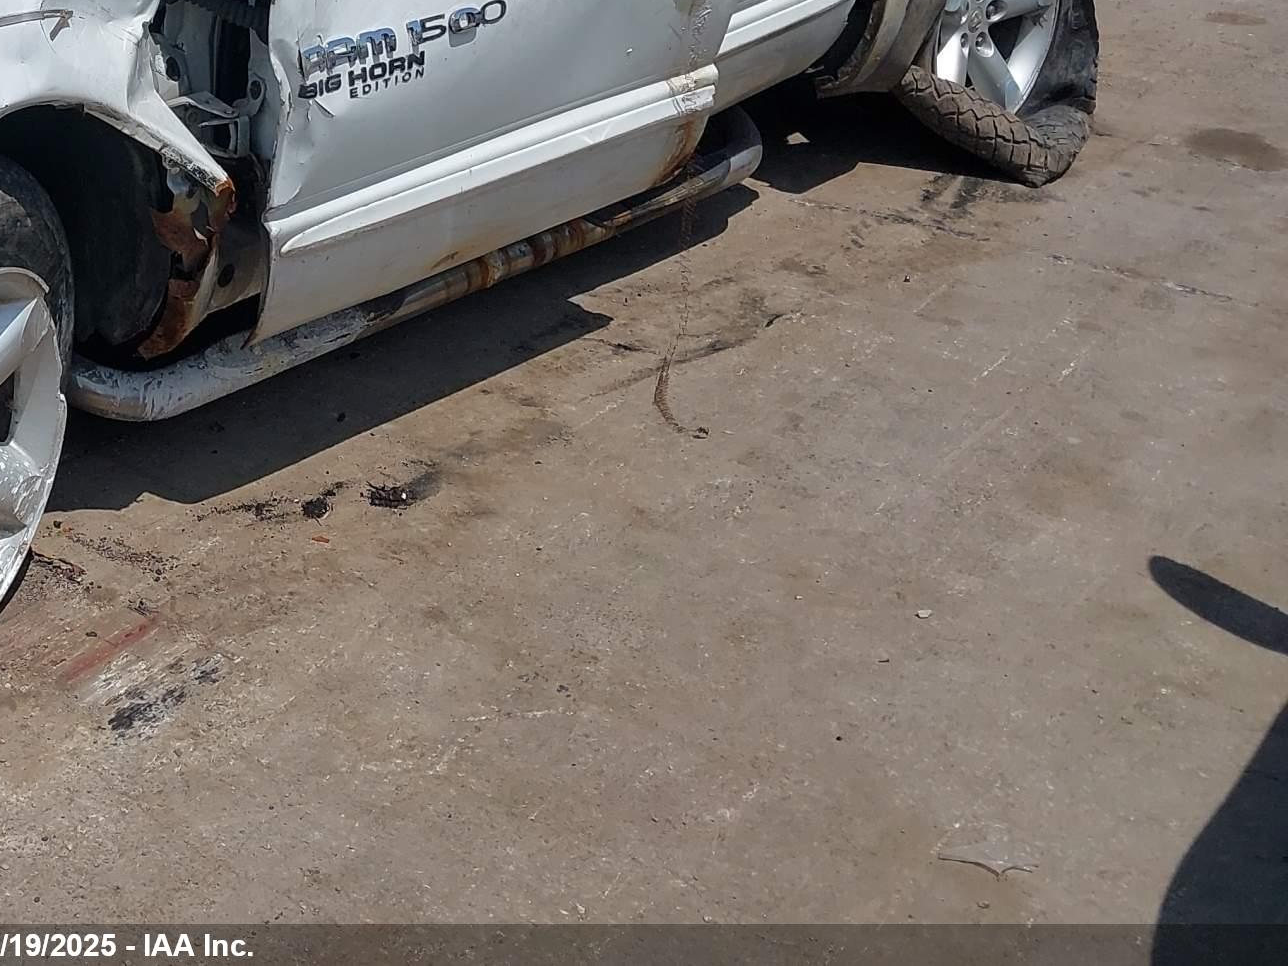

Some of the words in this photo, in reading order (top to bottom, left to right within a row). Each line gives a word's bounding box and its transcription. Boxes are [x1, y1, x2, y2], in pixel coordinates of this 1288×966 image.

[406, 0, 507, 48] 1500
[297, 73, 342, 100] BIG
[348, 50, 426, 87] HORN
[349, 67, 425, 98] EDITION
